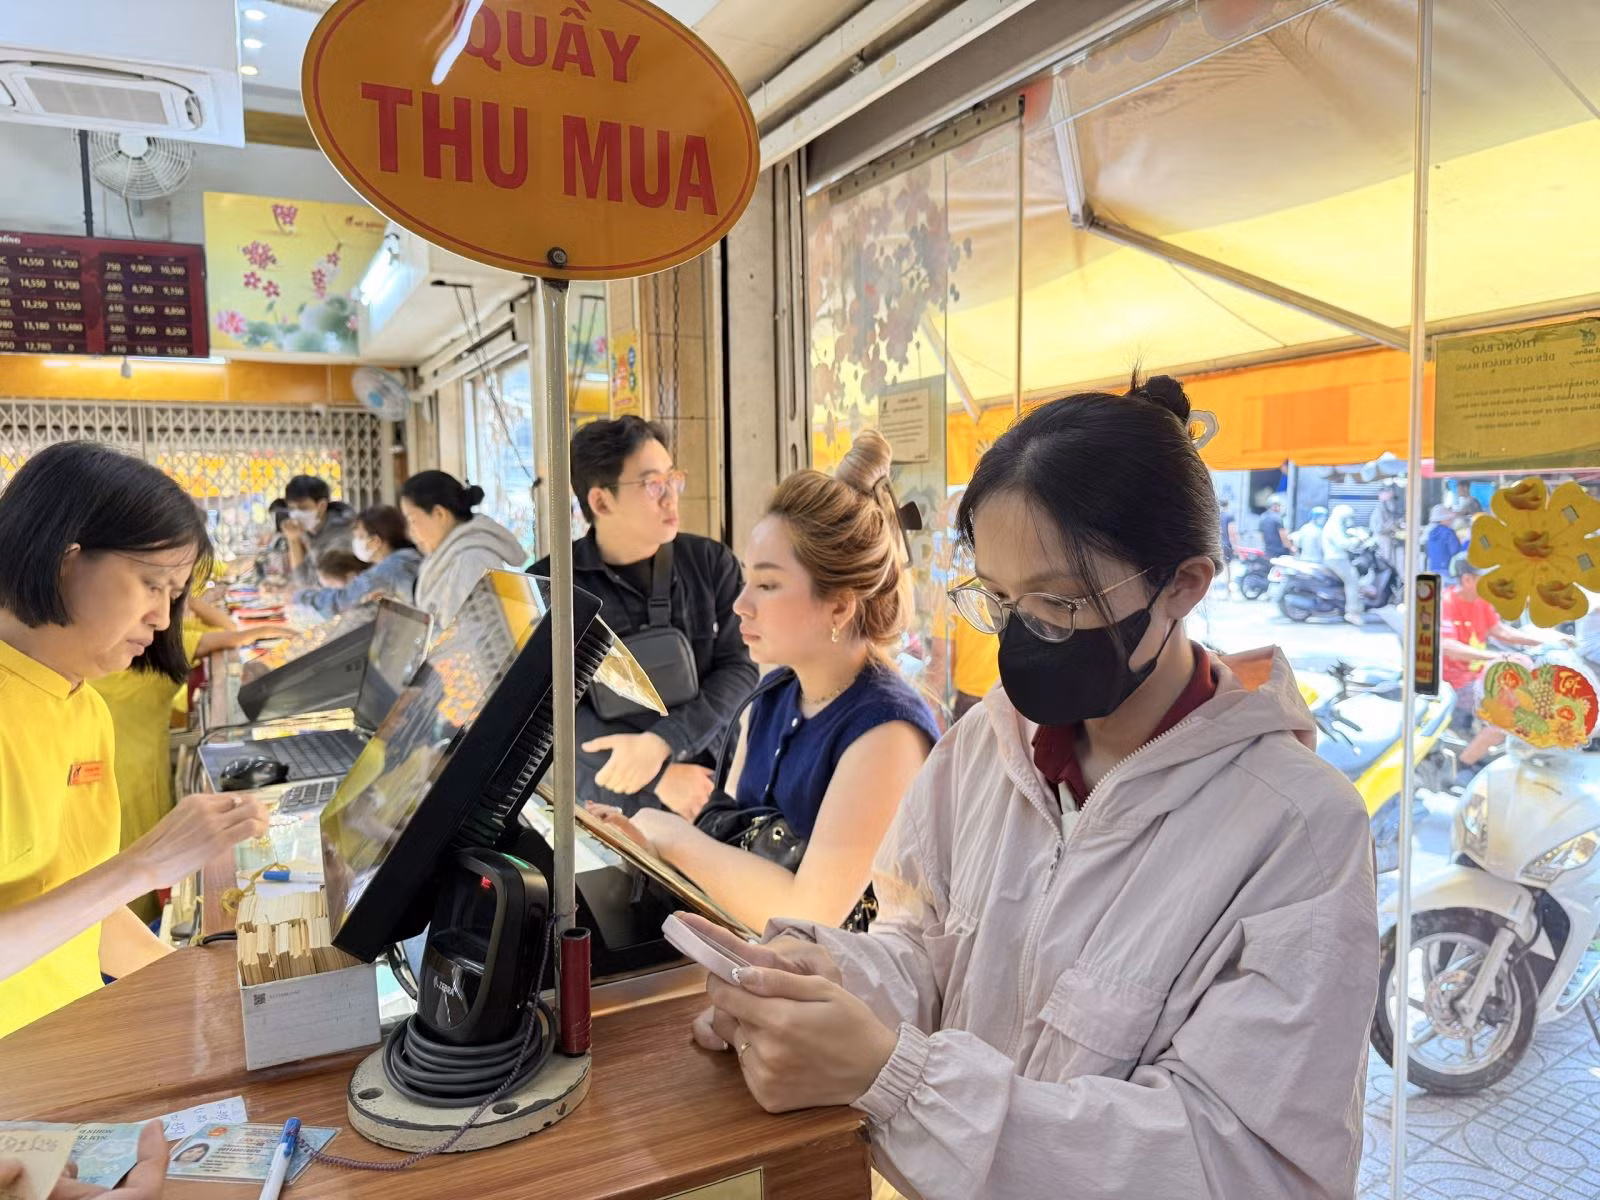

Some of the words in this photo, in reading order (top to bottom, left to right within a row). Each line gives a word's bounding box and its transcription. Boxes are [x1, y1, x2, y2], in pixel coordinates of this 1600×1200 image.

[361, 82, 528, 190] THU
[562, 114, 718, 216] MUA
[18, 257, 45, 267] 14,550
[52, 259, 78, 269] 14,700
[20, 278, 46, 289] 14,550
[54, 280, 80, 290] 14,700
[21, 300, 48, 309] 13,250
